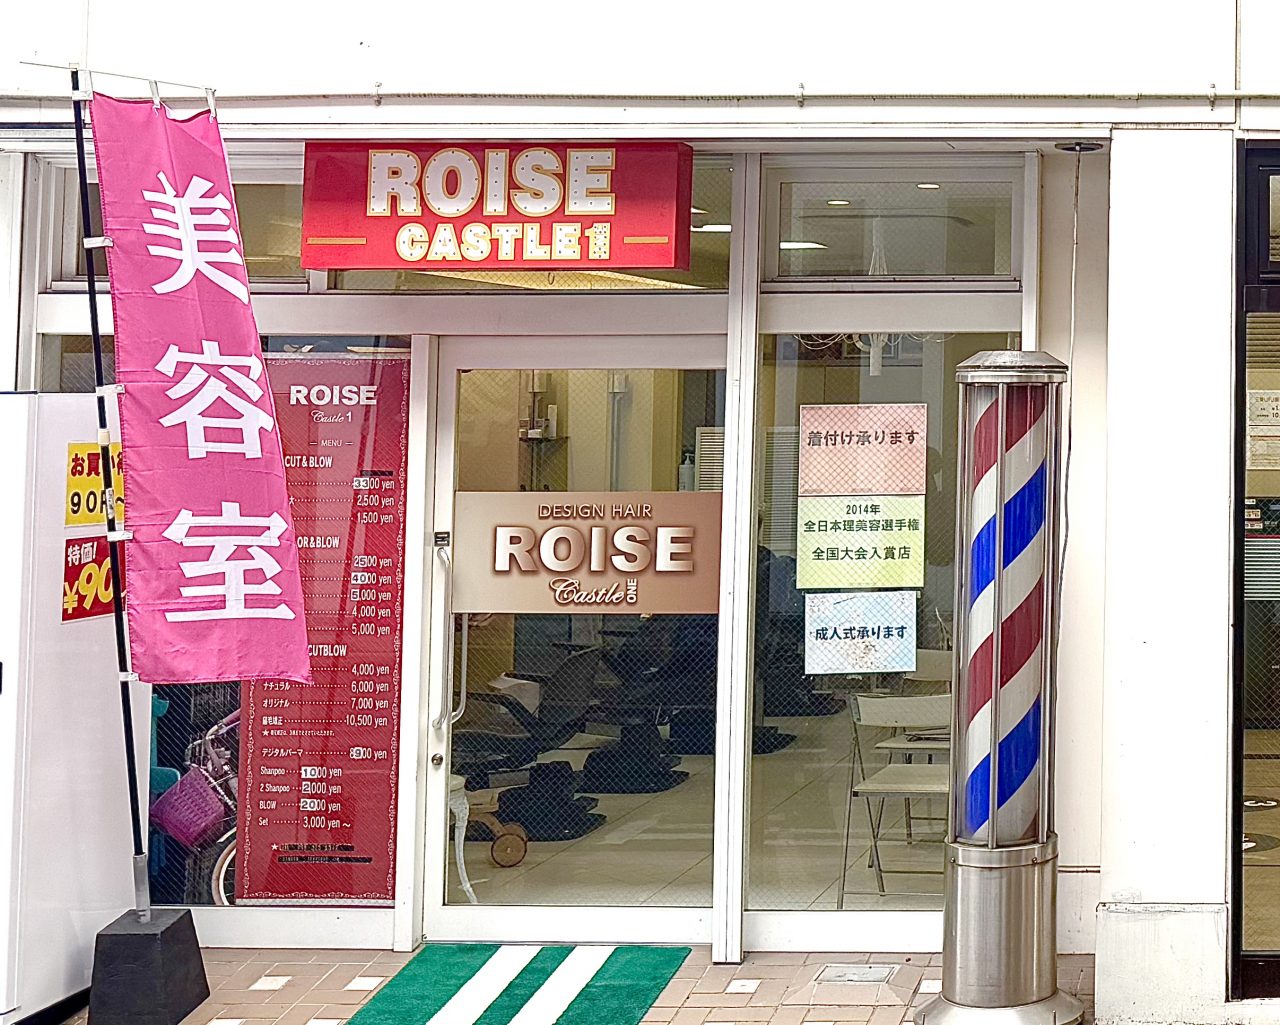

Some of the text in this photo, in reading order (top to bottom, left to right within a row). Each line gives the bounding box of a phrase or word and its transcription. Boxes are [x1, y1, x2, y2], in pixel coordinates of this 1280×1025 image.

[366, 147, 616, 217] ROISE
[141, 171, 296, 621] 美容室
[289, 385, 378, 406] ROISE
[310, 410, 352, 423] Castle 1
[321, 439, 342, 447] MENU
[807, 430, 919, 446] 着付け承ります
[353, 477, 395, 492] 3300 yen
[357, 495, 379, 507] 2,500
[380, 497, 394, 509] yen
[538, 504, 652, 518] DESIGN HAIR
[846, 504, 881, 515] 2014年
[357, 512, 393, 526] 1,500 yen
[804, 519, 920, 533] 全日本理美容選手権
[494, 526, 695, 572] ROISE
[812, 546, 911, 560] 全国大会入賞店
[379, 558, 392, 569] yen
[351, 572, 392, 587] 4000 yen
[377, 591, 391, 603] yen
[550, 577, 638, 604] Castle ONE
[352, 605, 391, 619] 4,000 yen
[351, 623, 390, 637] 5,000 yen
[815, 625, 907, 641] 成人式承ります
[352, 664, 390, 678] 4,000 yen
[263, 681, 389, 694] ナチュラル 6,000 yen
[262, 697, 389, 710] オリジナル 7,000 yen
[346, 714, 373, 726] 10,500
[374, 717, 388, 728] yen
[373, 750, 387, 761] yen
[301, 766, 327, 778] 1000
[329, 768, 342, 779] yen
[260, 784, 265, 792] 2
[328, 785, 341, 795] yen
[259, 799, 341, 813] BLOW 2000 yen
[258, 817, 269, 826] Set
[303, 816, 326, 829] 3,000
[327, 820, 340, 830] yen
